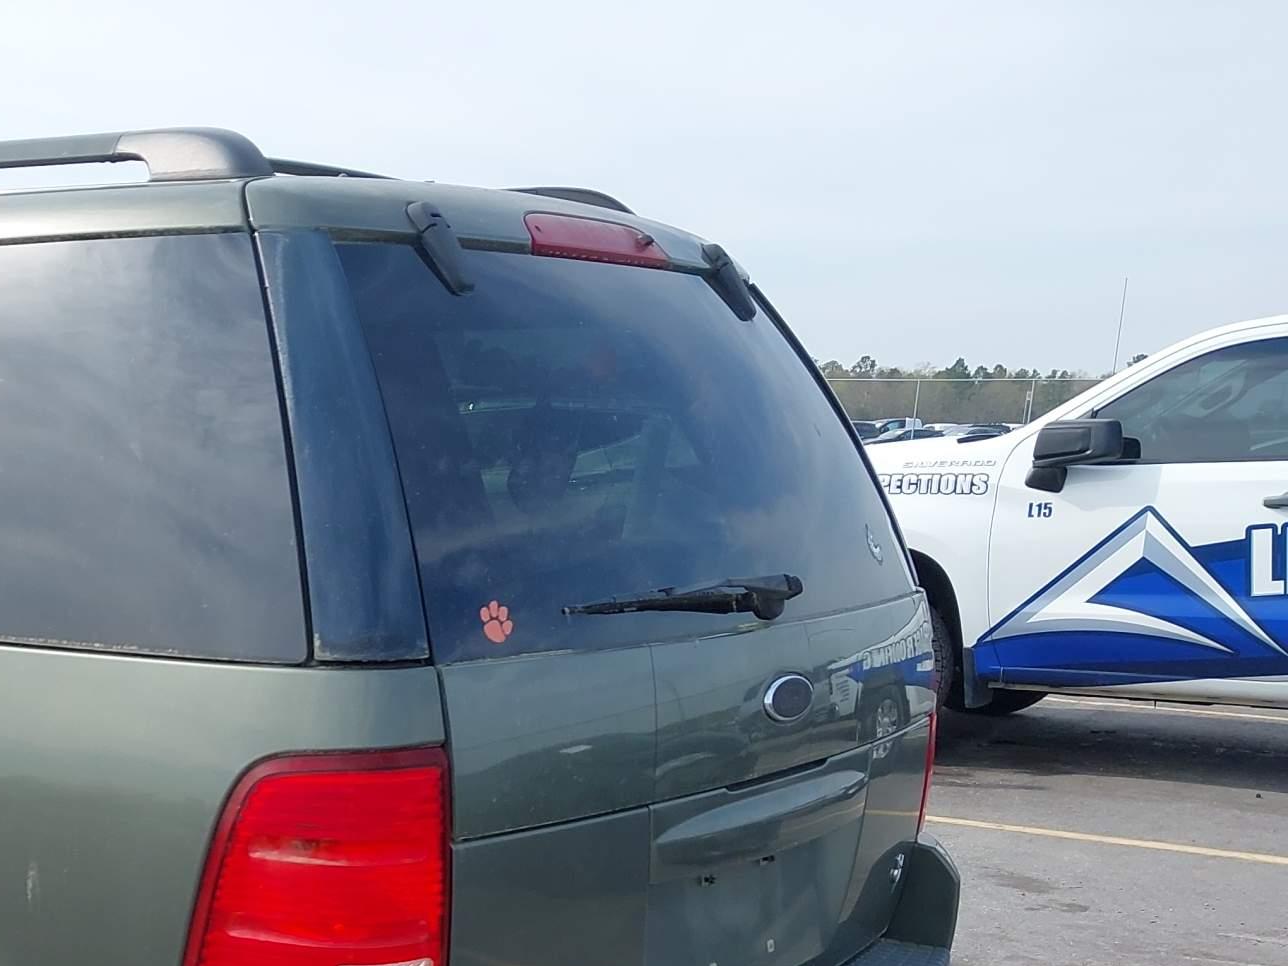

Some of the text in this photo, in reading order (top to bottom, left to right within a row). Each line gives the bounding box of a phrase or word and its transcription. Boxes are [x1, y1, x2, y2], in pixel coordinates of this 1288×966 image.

[902, 459, 997, 469] SILVERADO
[1027, 502, 1053, 519] L15
[1248, 525, 1288, 597] L
